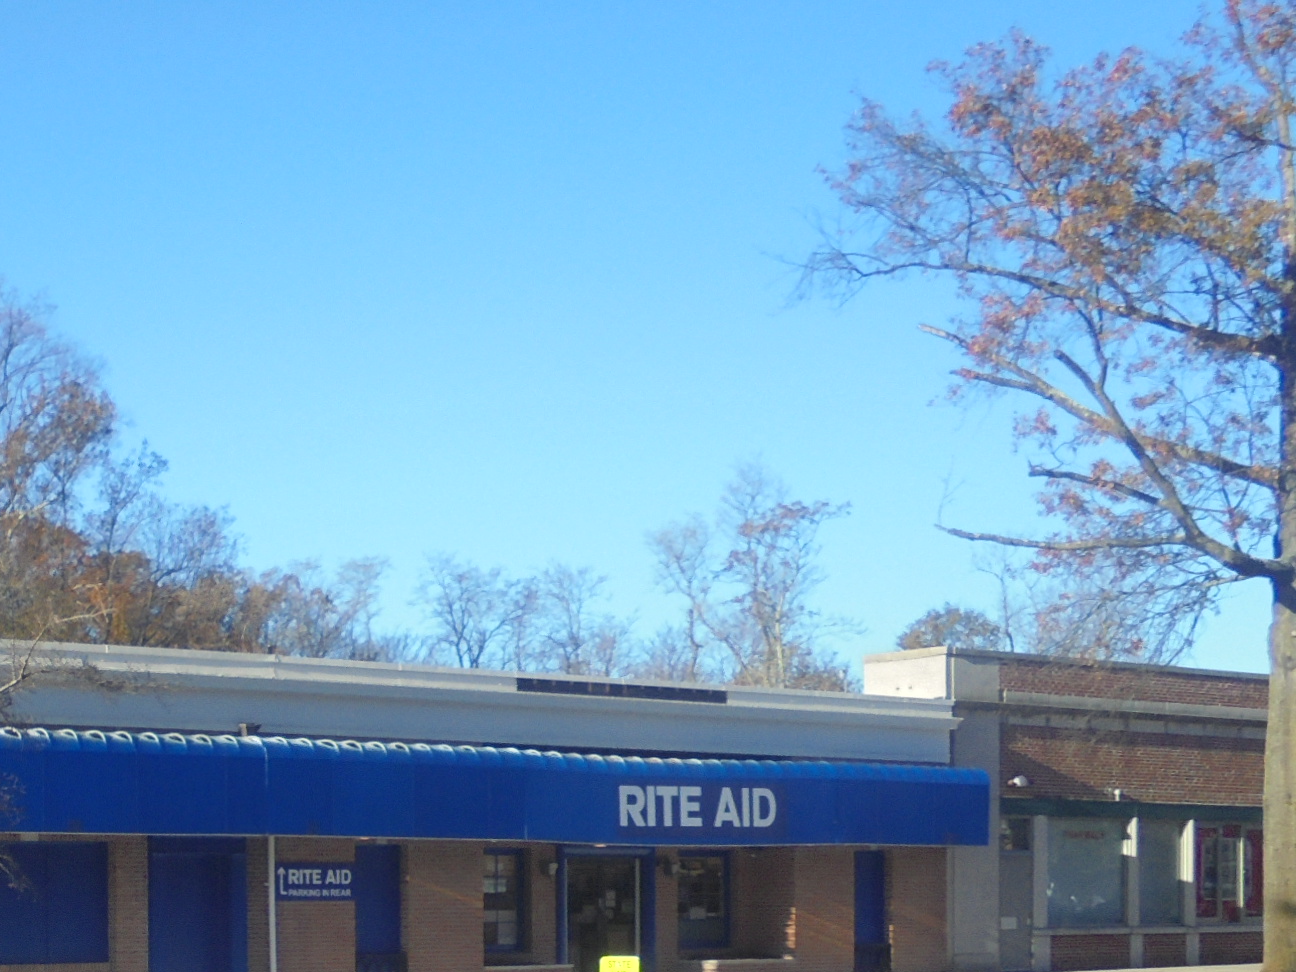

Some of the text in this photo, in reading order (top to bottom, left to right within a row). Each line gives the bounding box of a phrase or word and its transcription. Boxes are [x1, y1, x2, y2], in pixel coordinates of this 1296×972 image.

[619, 785, 777, 828] RITE AID
[288, 869, 352, 884] RITE AID
[288, 889, 351, 897] PARKING IN REAR
